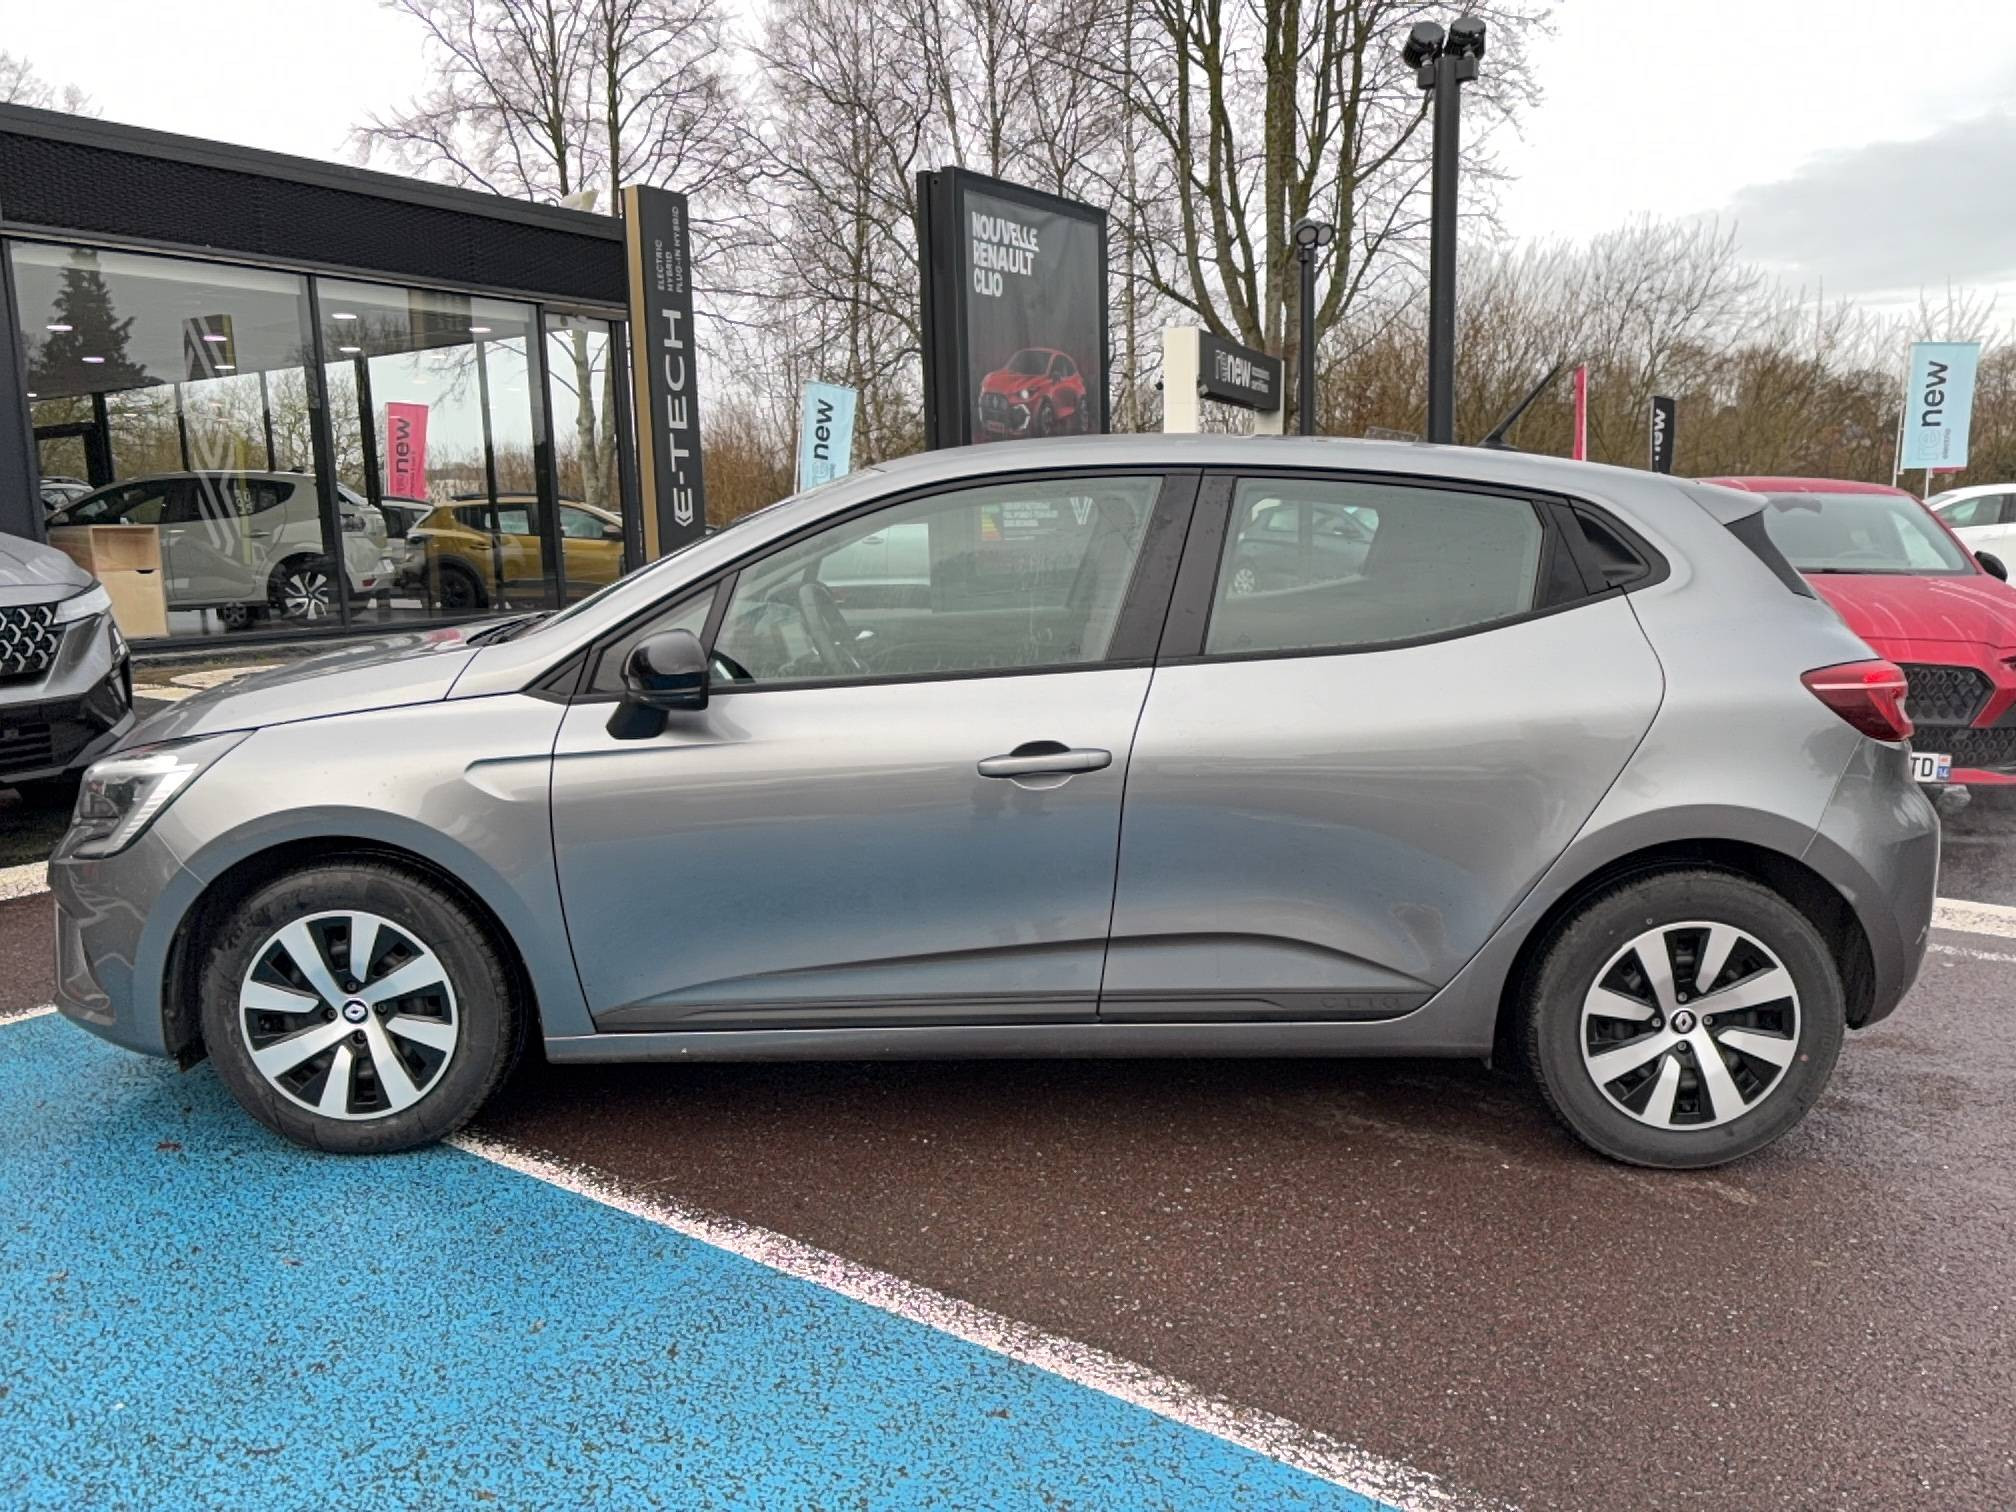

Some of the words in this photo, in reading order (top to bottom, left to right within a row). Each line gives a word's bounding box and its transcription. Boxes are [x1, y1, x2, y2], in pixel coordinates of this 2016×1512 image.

[672, 206, 681, 247] HYBRID
[972, 211, 1040, 252] NOUVELLE
[655, 239, 665, 291] ELECTRIC
[665, 251, 674, 292] HYBRID
[675, 249, 684, 294] PLUG-IN
[973, 239, 1034, 276] RENAULT
[973, 267, 1003, 297] CLIO
[661, 308, 694, 527] E-TECH
